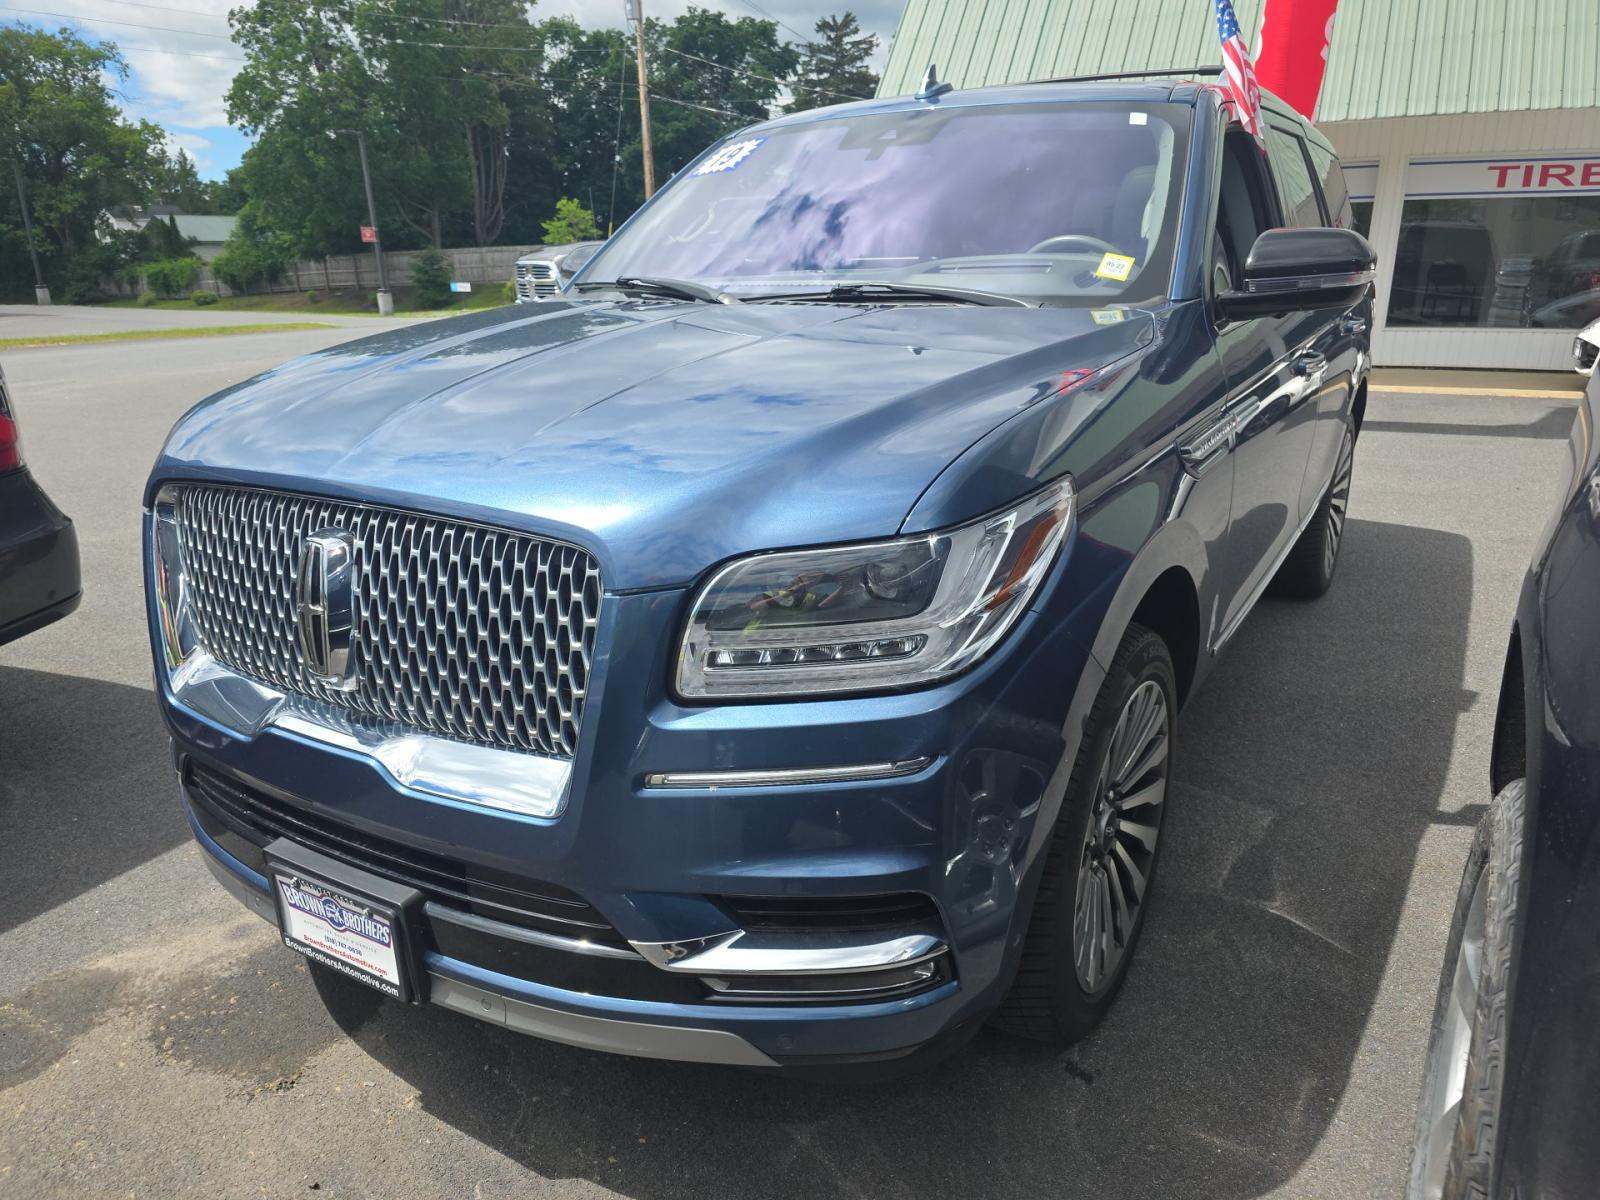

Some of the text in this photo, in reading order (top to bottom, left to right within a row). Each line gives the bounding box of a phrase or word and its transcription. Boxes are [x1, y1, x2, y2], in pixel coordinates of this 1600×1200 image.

[1488, 163, 1600, 188] TIRE
[282, 884, 326, 917] BROWN
[342, 909, 390, 944] BROTHERS
[284, 937, 399, 997] BrownBrothersAutomotive.com
